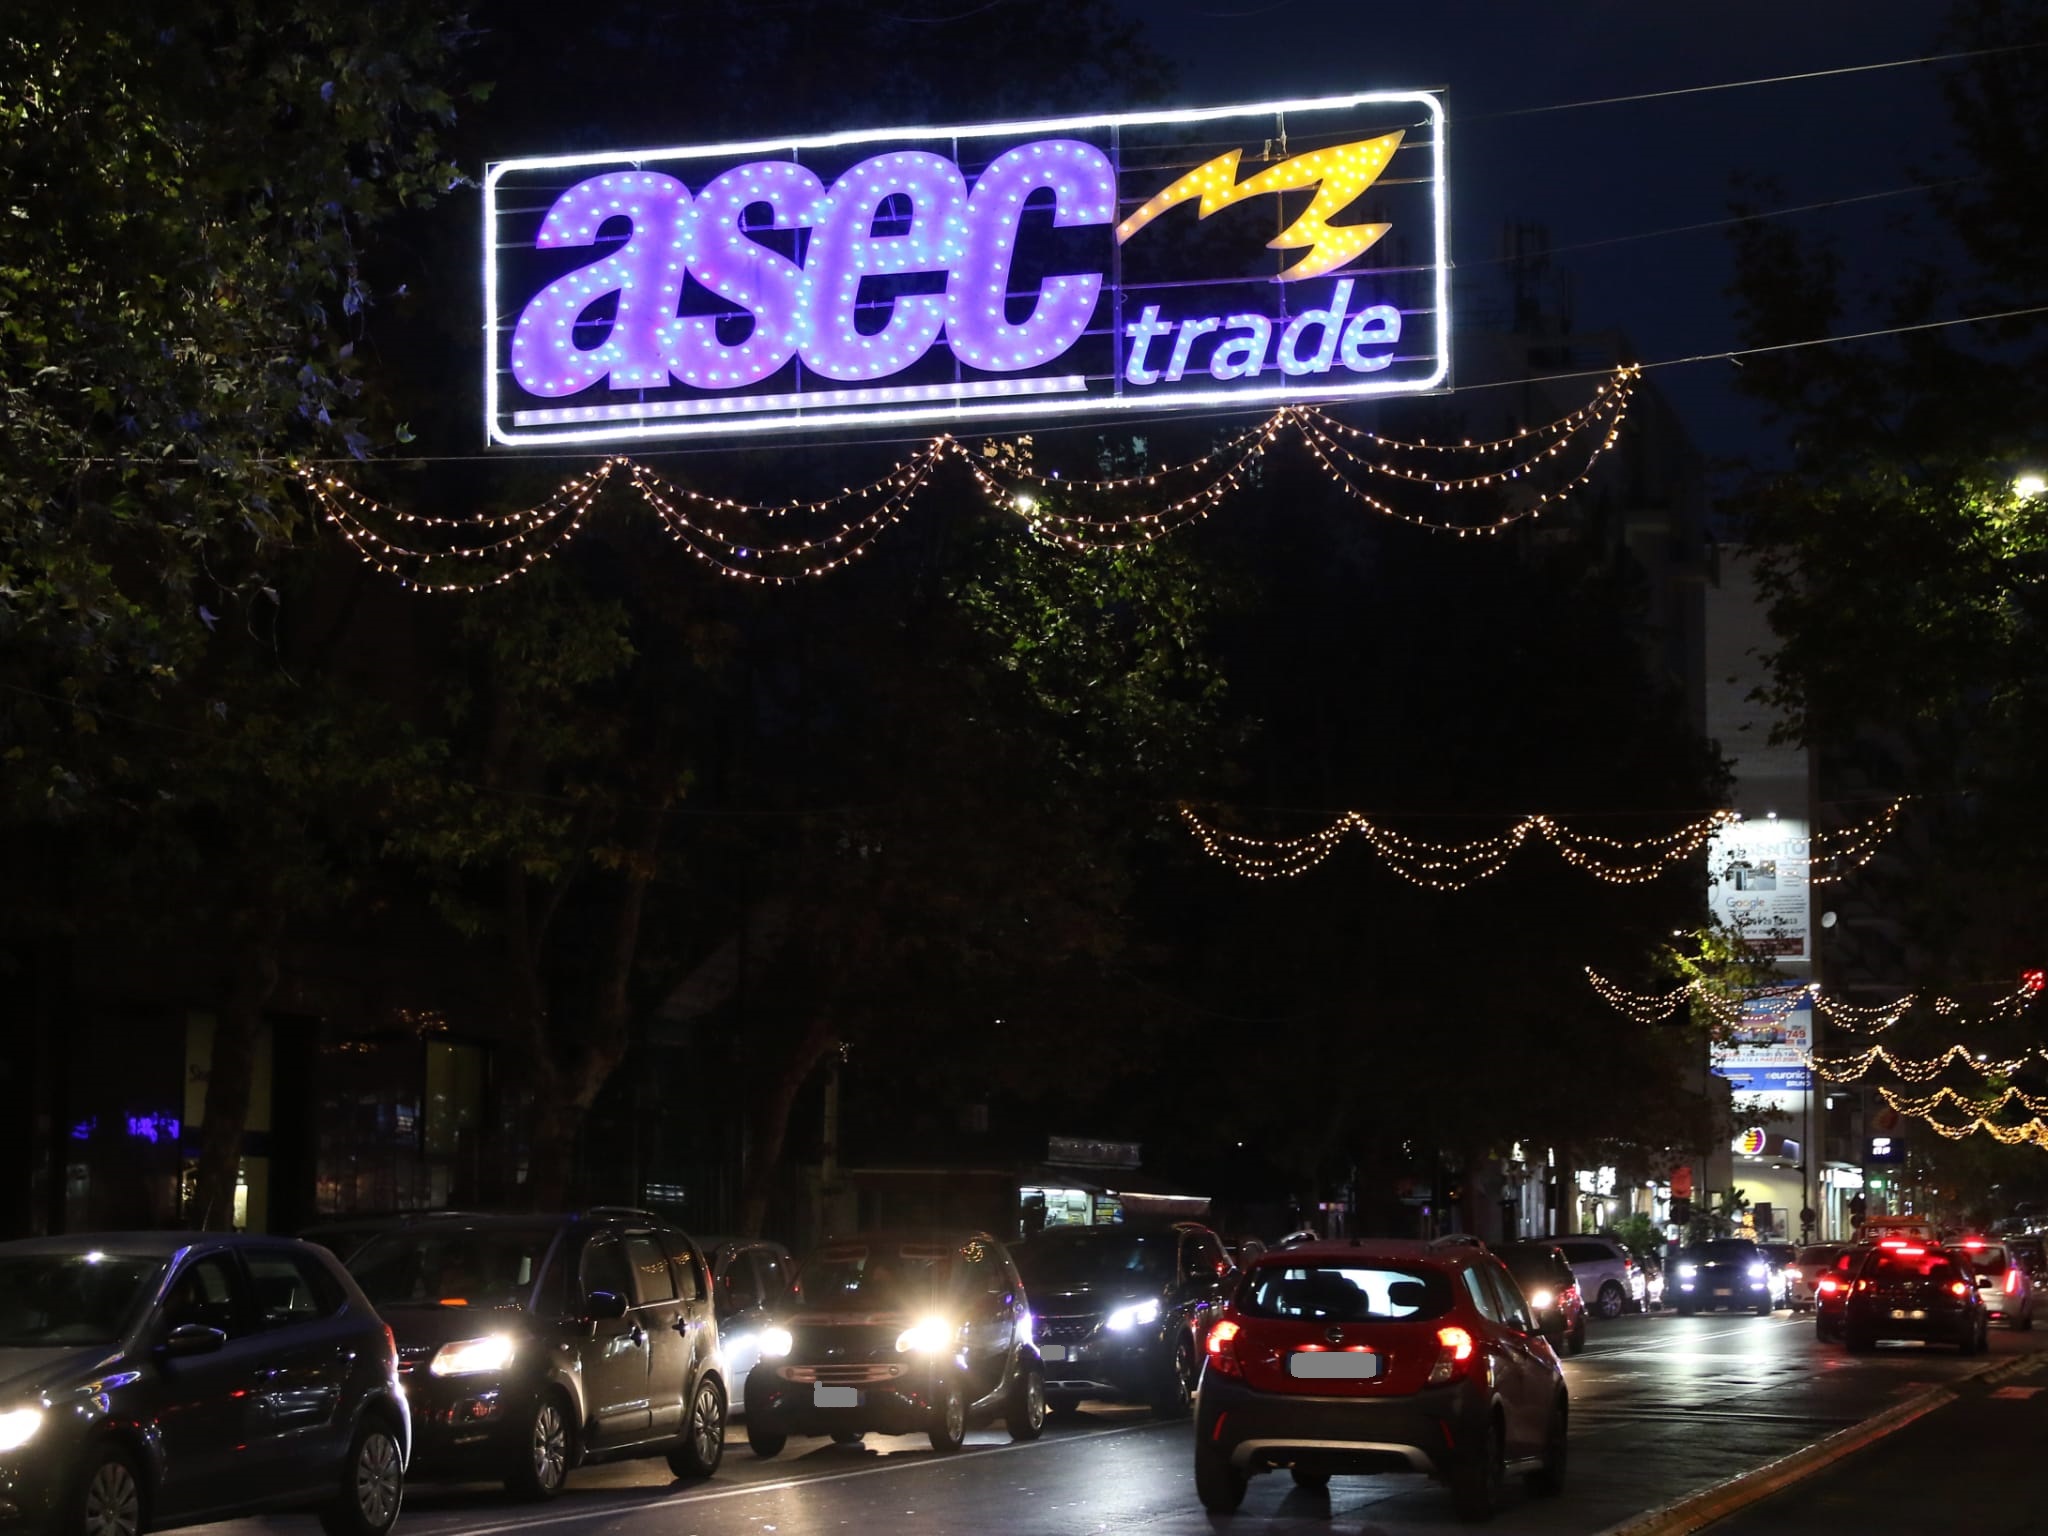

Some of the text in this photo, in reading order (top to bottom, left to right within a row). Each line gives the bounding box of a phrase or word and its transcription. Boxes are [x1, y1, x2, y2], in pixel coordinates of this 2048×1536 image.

[511, 139, 1119, 398] asec
[1126, 280, 1402, 386] trade
[1726, 896, 1765, 910] Google
[1787, 1030, 1806, 1039] 749
